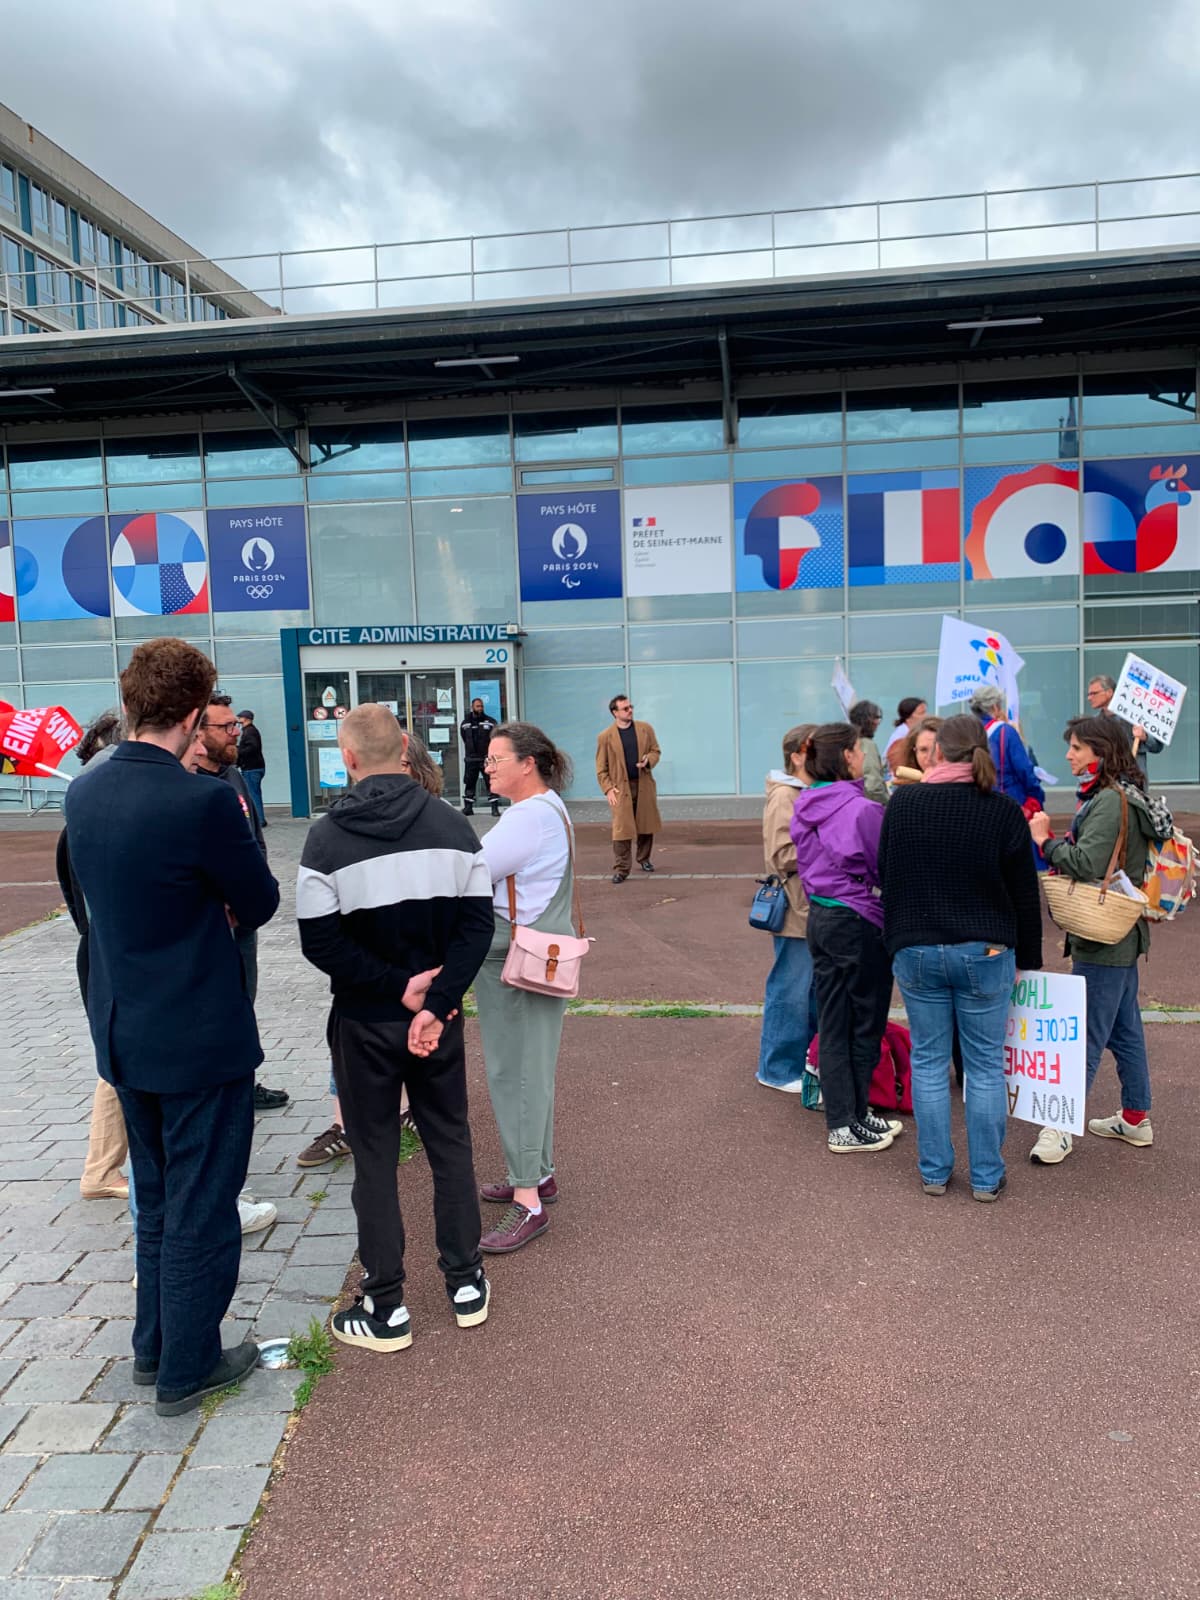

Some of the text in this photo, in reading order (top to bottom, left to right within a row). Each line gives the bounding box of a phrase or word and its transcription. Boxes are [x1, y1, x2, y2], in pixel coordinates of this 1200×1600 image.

[541, 502, 597, 515] PAYS HÔTE
[229, 516, 284, 528] PAYS HÔTE
[632, 529, 665, 538] PRÉFET
[633, 536, 723, 548] DE SEINE-ET-MARNE
[543, 561, 599, 572] PARIS 2024
[233, 573, 286, 583] PARIS 2024
[308, 625, 508, 645] CITE ADMINISTRATIVE
[485, 648, 508, 663] 20
[1131, 698, 1144, 710] LA
[1132, 687, 1165, 709] STOP
[1117, 703, 1128, 713] DE
[1035, 1015, 1078, 1042] ECOLE
[1006, 1081, 1075, 1126] NON A
